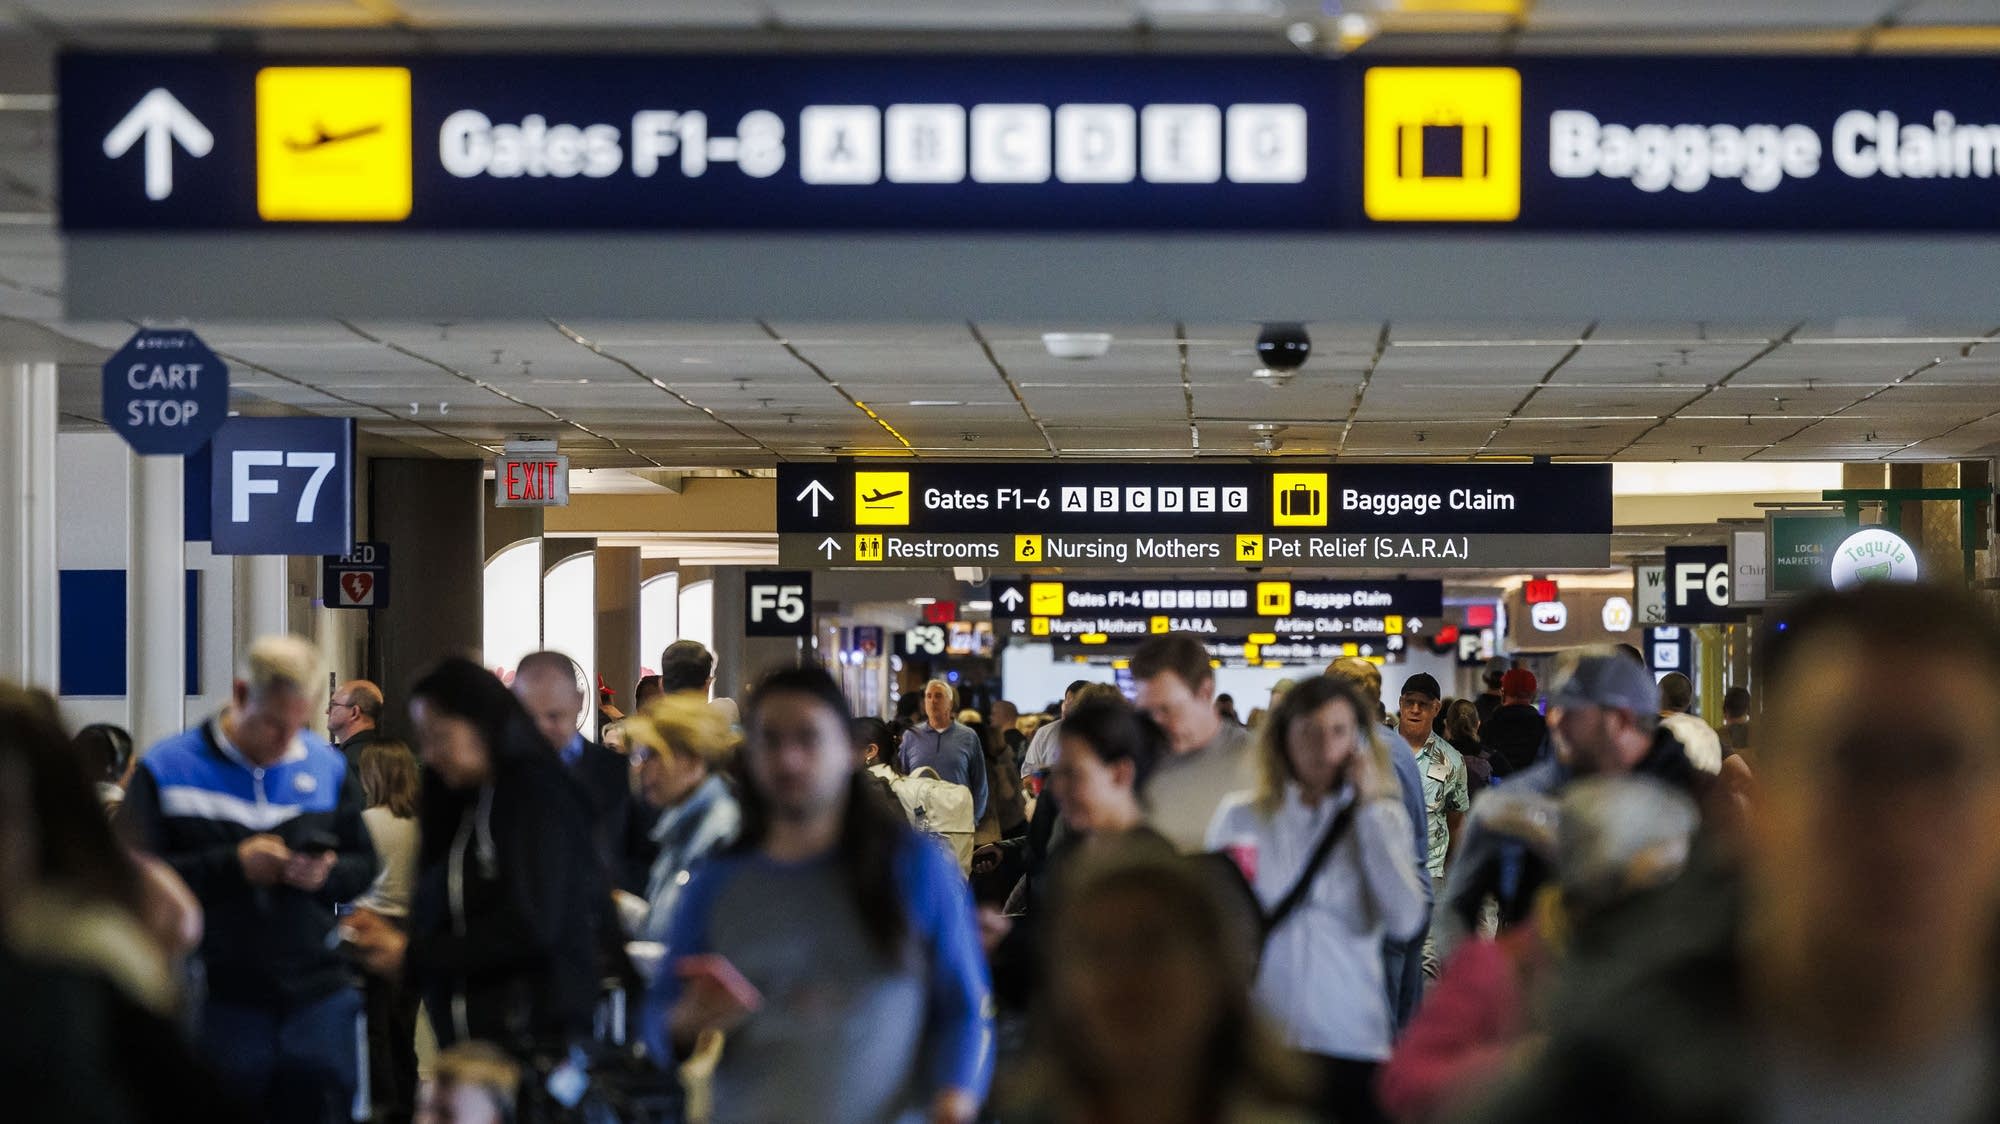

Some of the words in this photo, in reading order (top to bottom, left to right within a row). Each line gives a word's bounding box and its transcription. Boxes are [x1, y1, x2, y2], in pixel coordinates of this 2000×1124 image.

[439, 109, 623, 178] Gates
[1549, 109, 1822, 193] Baggage
[1832, 109, 2000, 179] Claim
[128, 363, 204, 391] CART
[127, 399, 199, 427] STOP
[231, 450, 336, 523] F7
[506, 461, 559, 500] EXIT
[924, 488, 989, 510] Gates
[1067, 491, 1082, 508] A
[1100, 491, 1113, 508] B
[1132, 491, 1145, 508] C
[1164, 491, 1178, 508] D
[1197, 491, 1209, 508] E
[1228, 491, 1242, 508] G
[1342, 489, 1441, 516] Baggage
[1449, 489, 1515, 511] Claim
[888, 538, 1000, 559] Restrooms
[1047, 538, 1128, 563] Nursing
[1136, 538, 1220, 559] Mothers
[1268, 538, 1302, 558] Pet
[1309, 537, 1367, 558] Relief
[1374, 536, 1469, 561] (S.A.R.A.)
[1845, 540, 1906, 565] Tequila
[1675, 562, 1729, 607] F6
[751, 585, 804, 624] F5
[1067, 591, 1106, 608] Gates
[1295, 590, 1351, 609] Baggage
[1352, 590, 1393, 607] Claim
[1050, 618, 1096, 635] Nursing
[1097, 618, 1146, 633] Mothers
[1274, 617, 1315, 633] Airline
[1315, 617, 1344, 633] Club
[1352, 617, 1384, 633] Delta
[906, 625, 946, 656] F3
